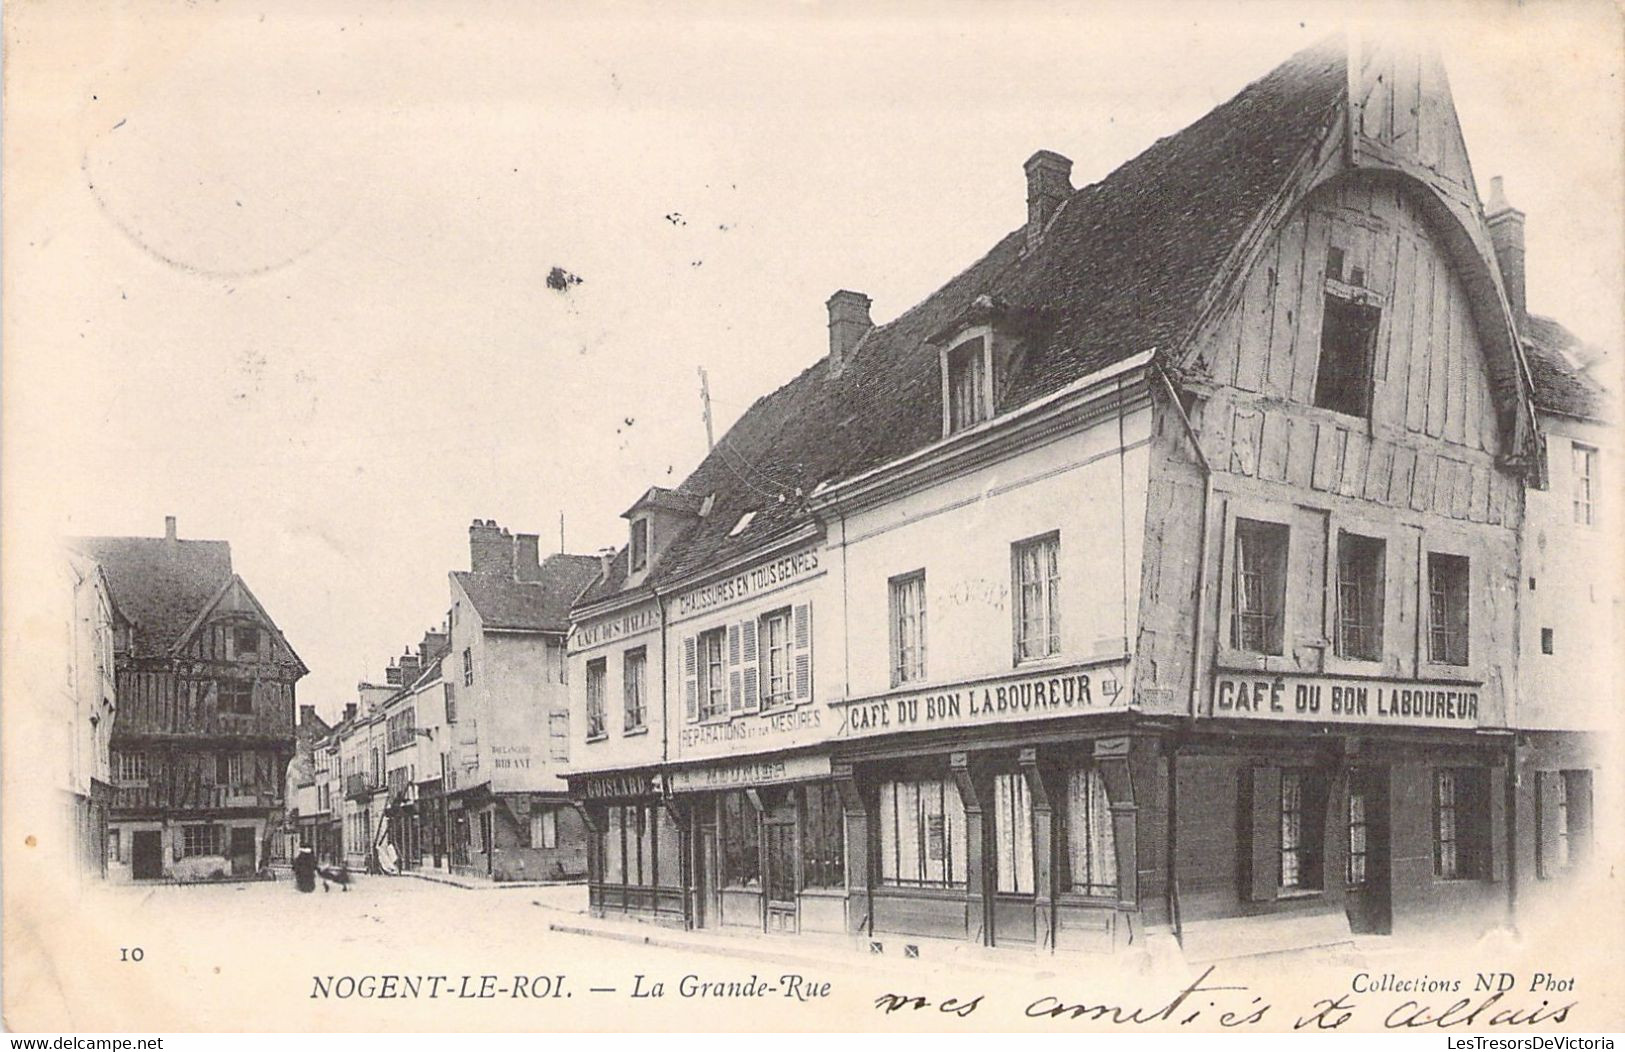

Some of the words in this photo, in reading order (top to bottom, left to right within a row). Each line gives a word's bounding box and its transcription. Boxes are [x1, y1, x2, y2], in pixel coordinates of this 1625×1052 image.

[737, 573, 749, 597] EN
[751, 564, 777, 592] TOUS
[850, 699, 890, 730] CAFÉ
[898, 698, 918, 723] DU
[926, 692, 961, 720] BON
[969, 674, 1092, 714] LABOUREUR
[1218, 675, 1285, 714] CAFÉ
[1295, 684, 1321, 714] DU
[1331, 686, 1368, 717] BON
[1377, 688, 1480, 721] LABOUREUR
